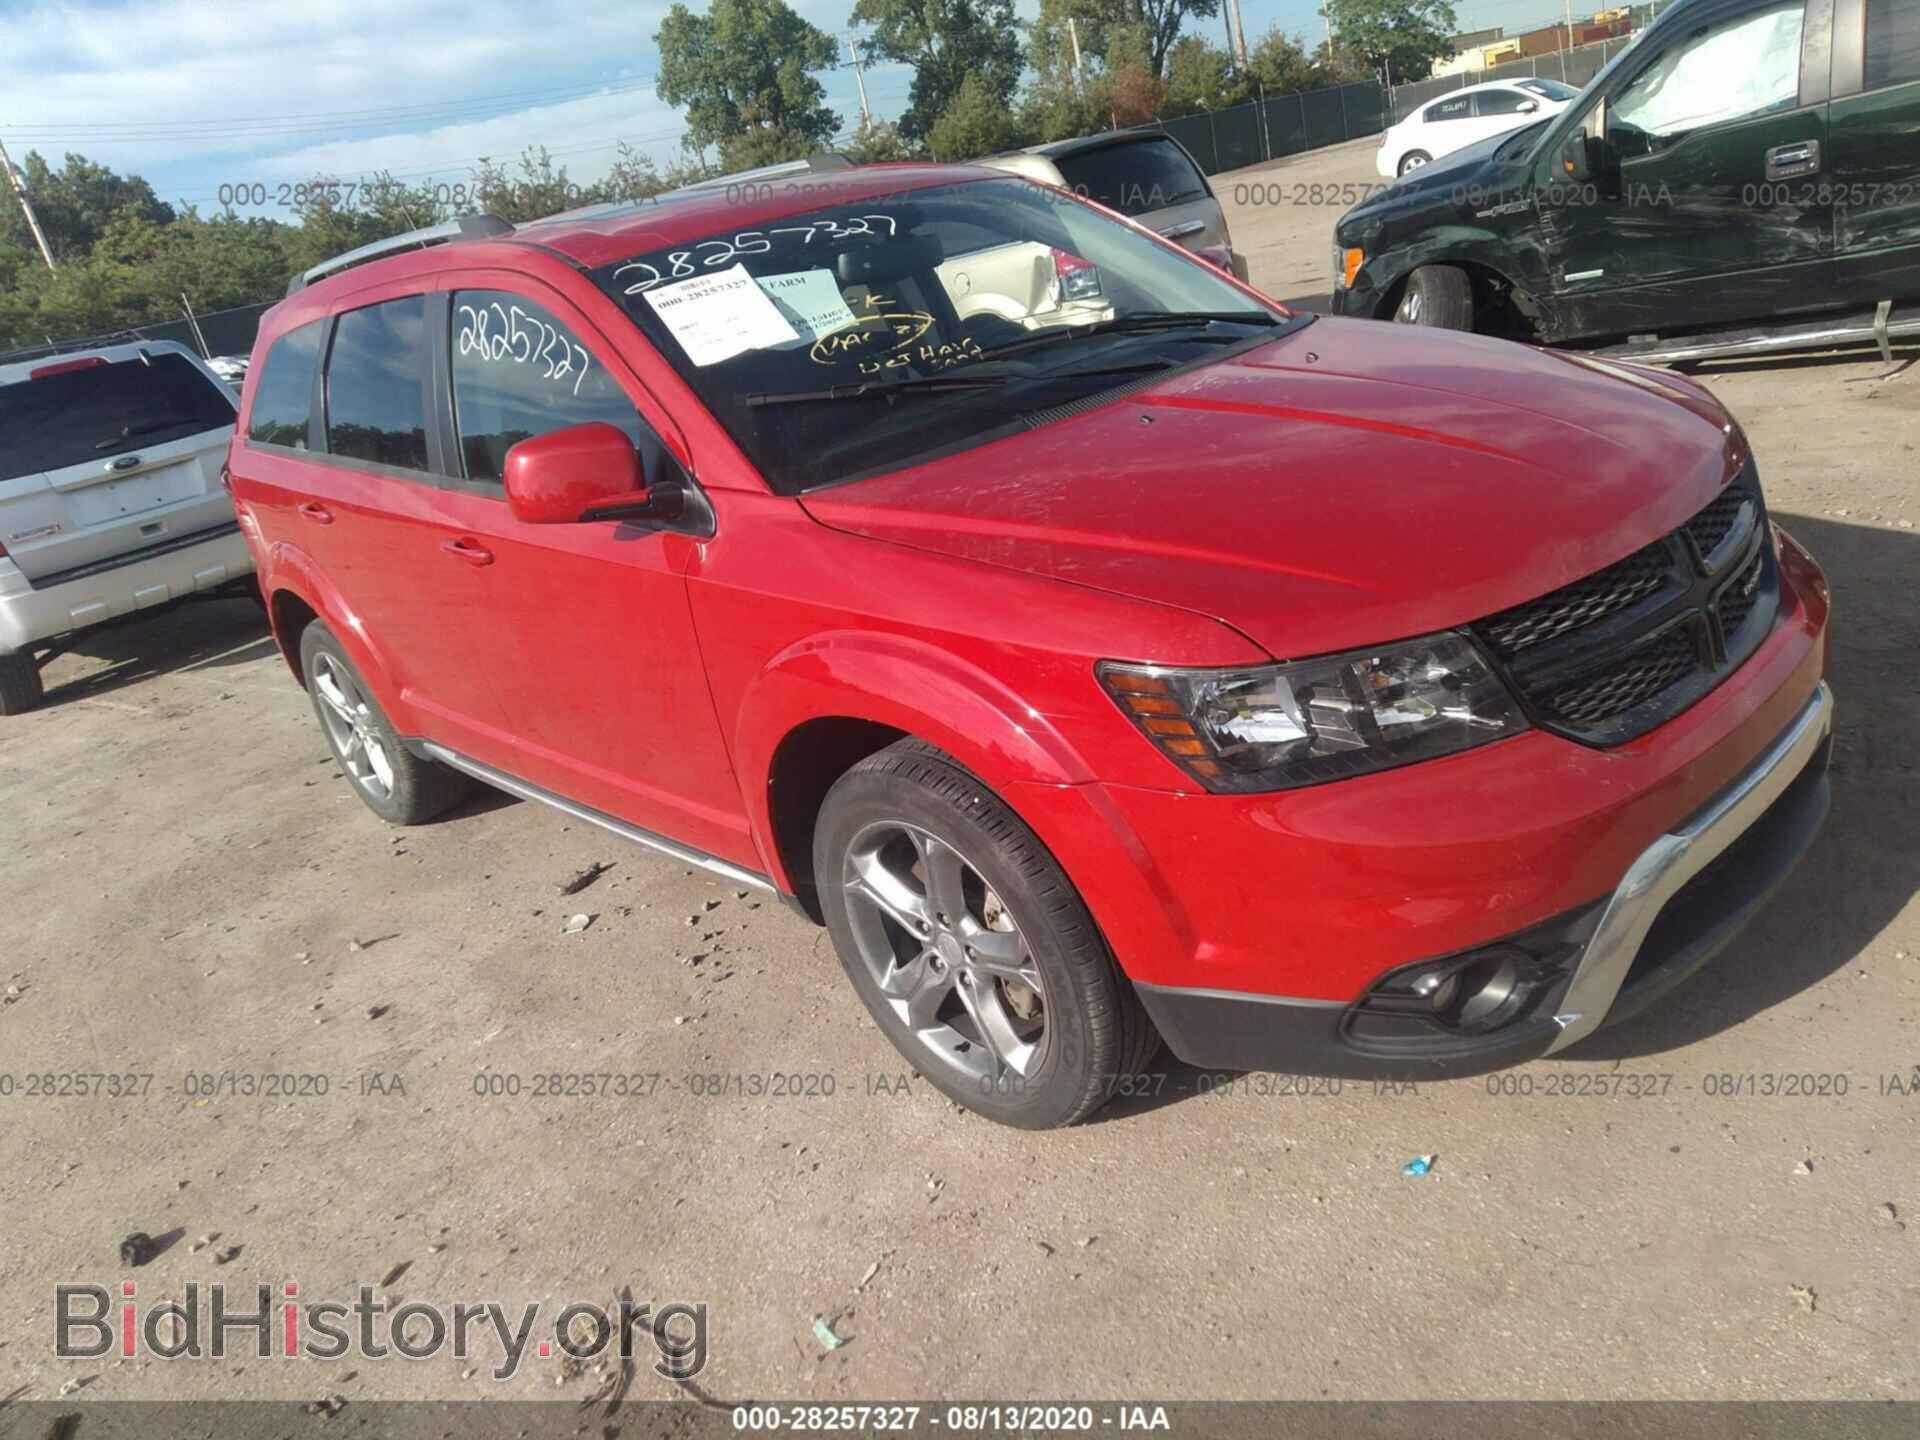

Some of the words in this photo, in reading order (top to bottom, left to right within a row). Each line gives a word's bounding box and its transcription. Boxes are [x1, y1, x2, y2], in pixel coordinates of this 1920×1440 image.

[612, 215, 897, 295] 28257327
[769, 276, 807, 289] FARM
[459, 302, 589, 397] 28257327
